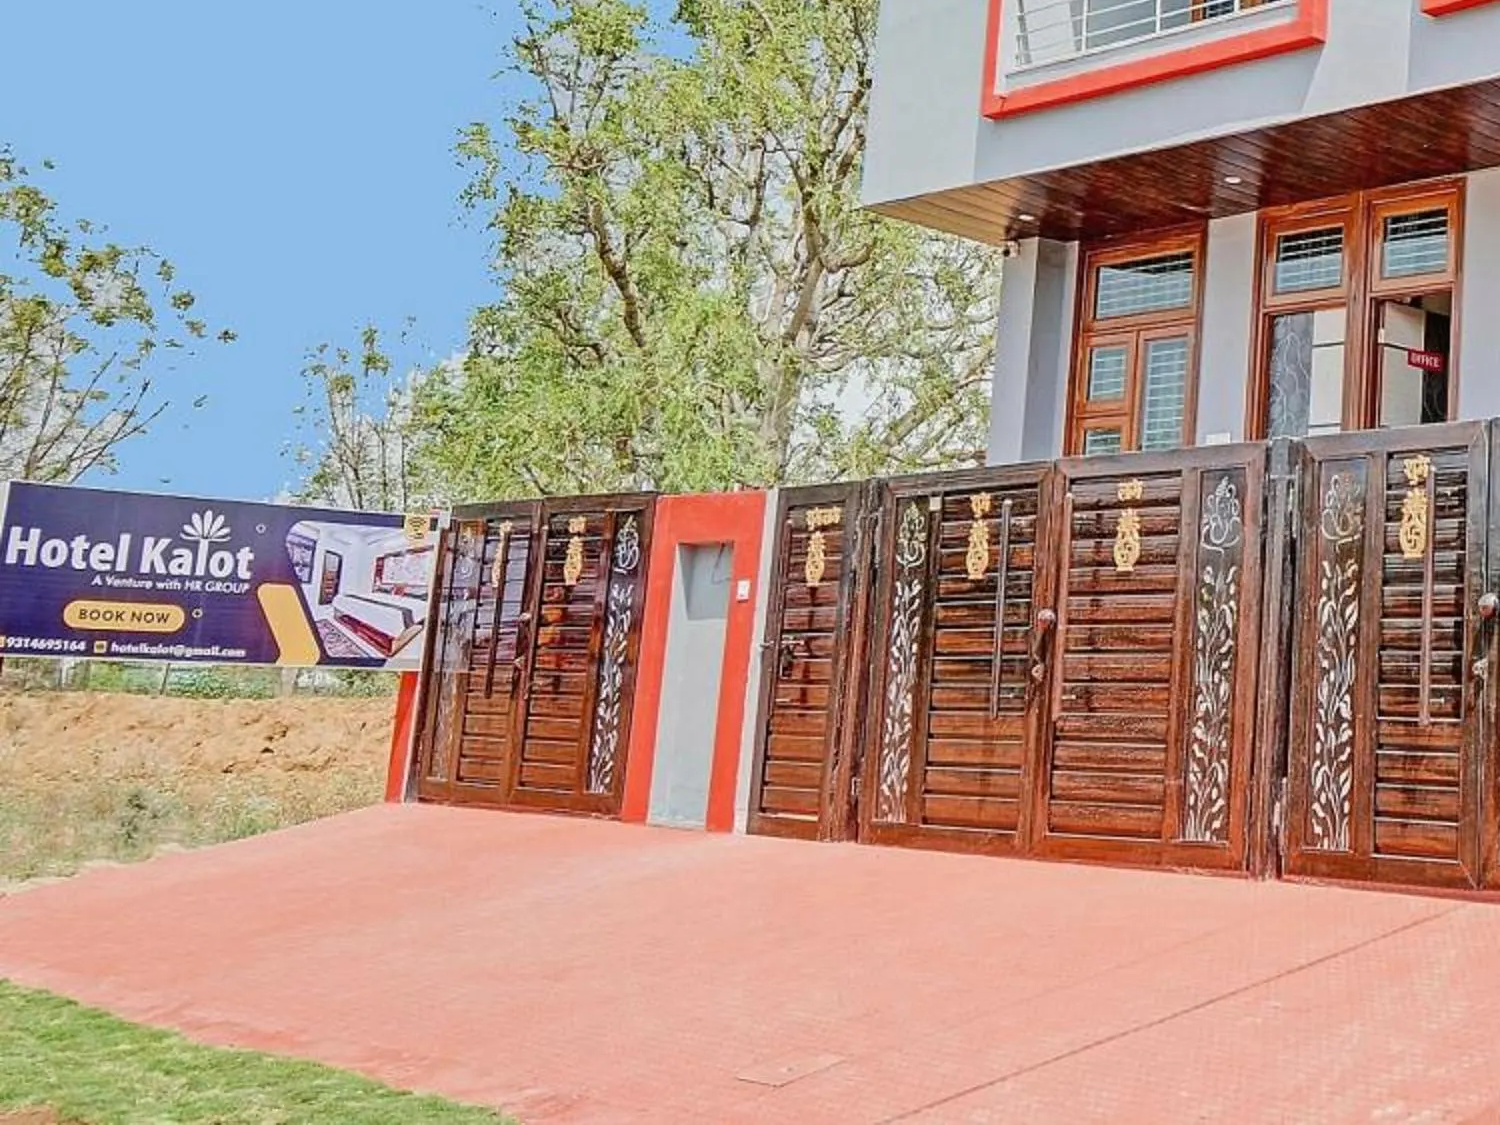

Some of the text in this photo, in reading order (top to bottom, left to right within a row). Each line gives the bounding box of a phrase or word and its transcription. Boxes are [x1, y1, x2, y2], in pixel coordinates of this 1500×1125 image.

[5, 525, 255, 579] Hotel Kalot
[91, 576, 250, 595] A Venture with HR GROUP
[78, 608, 171, 624] BOOK NOW
